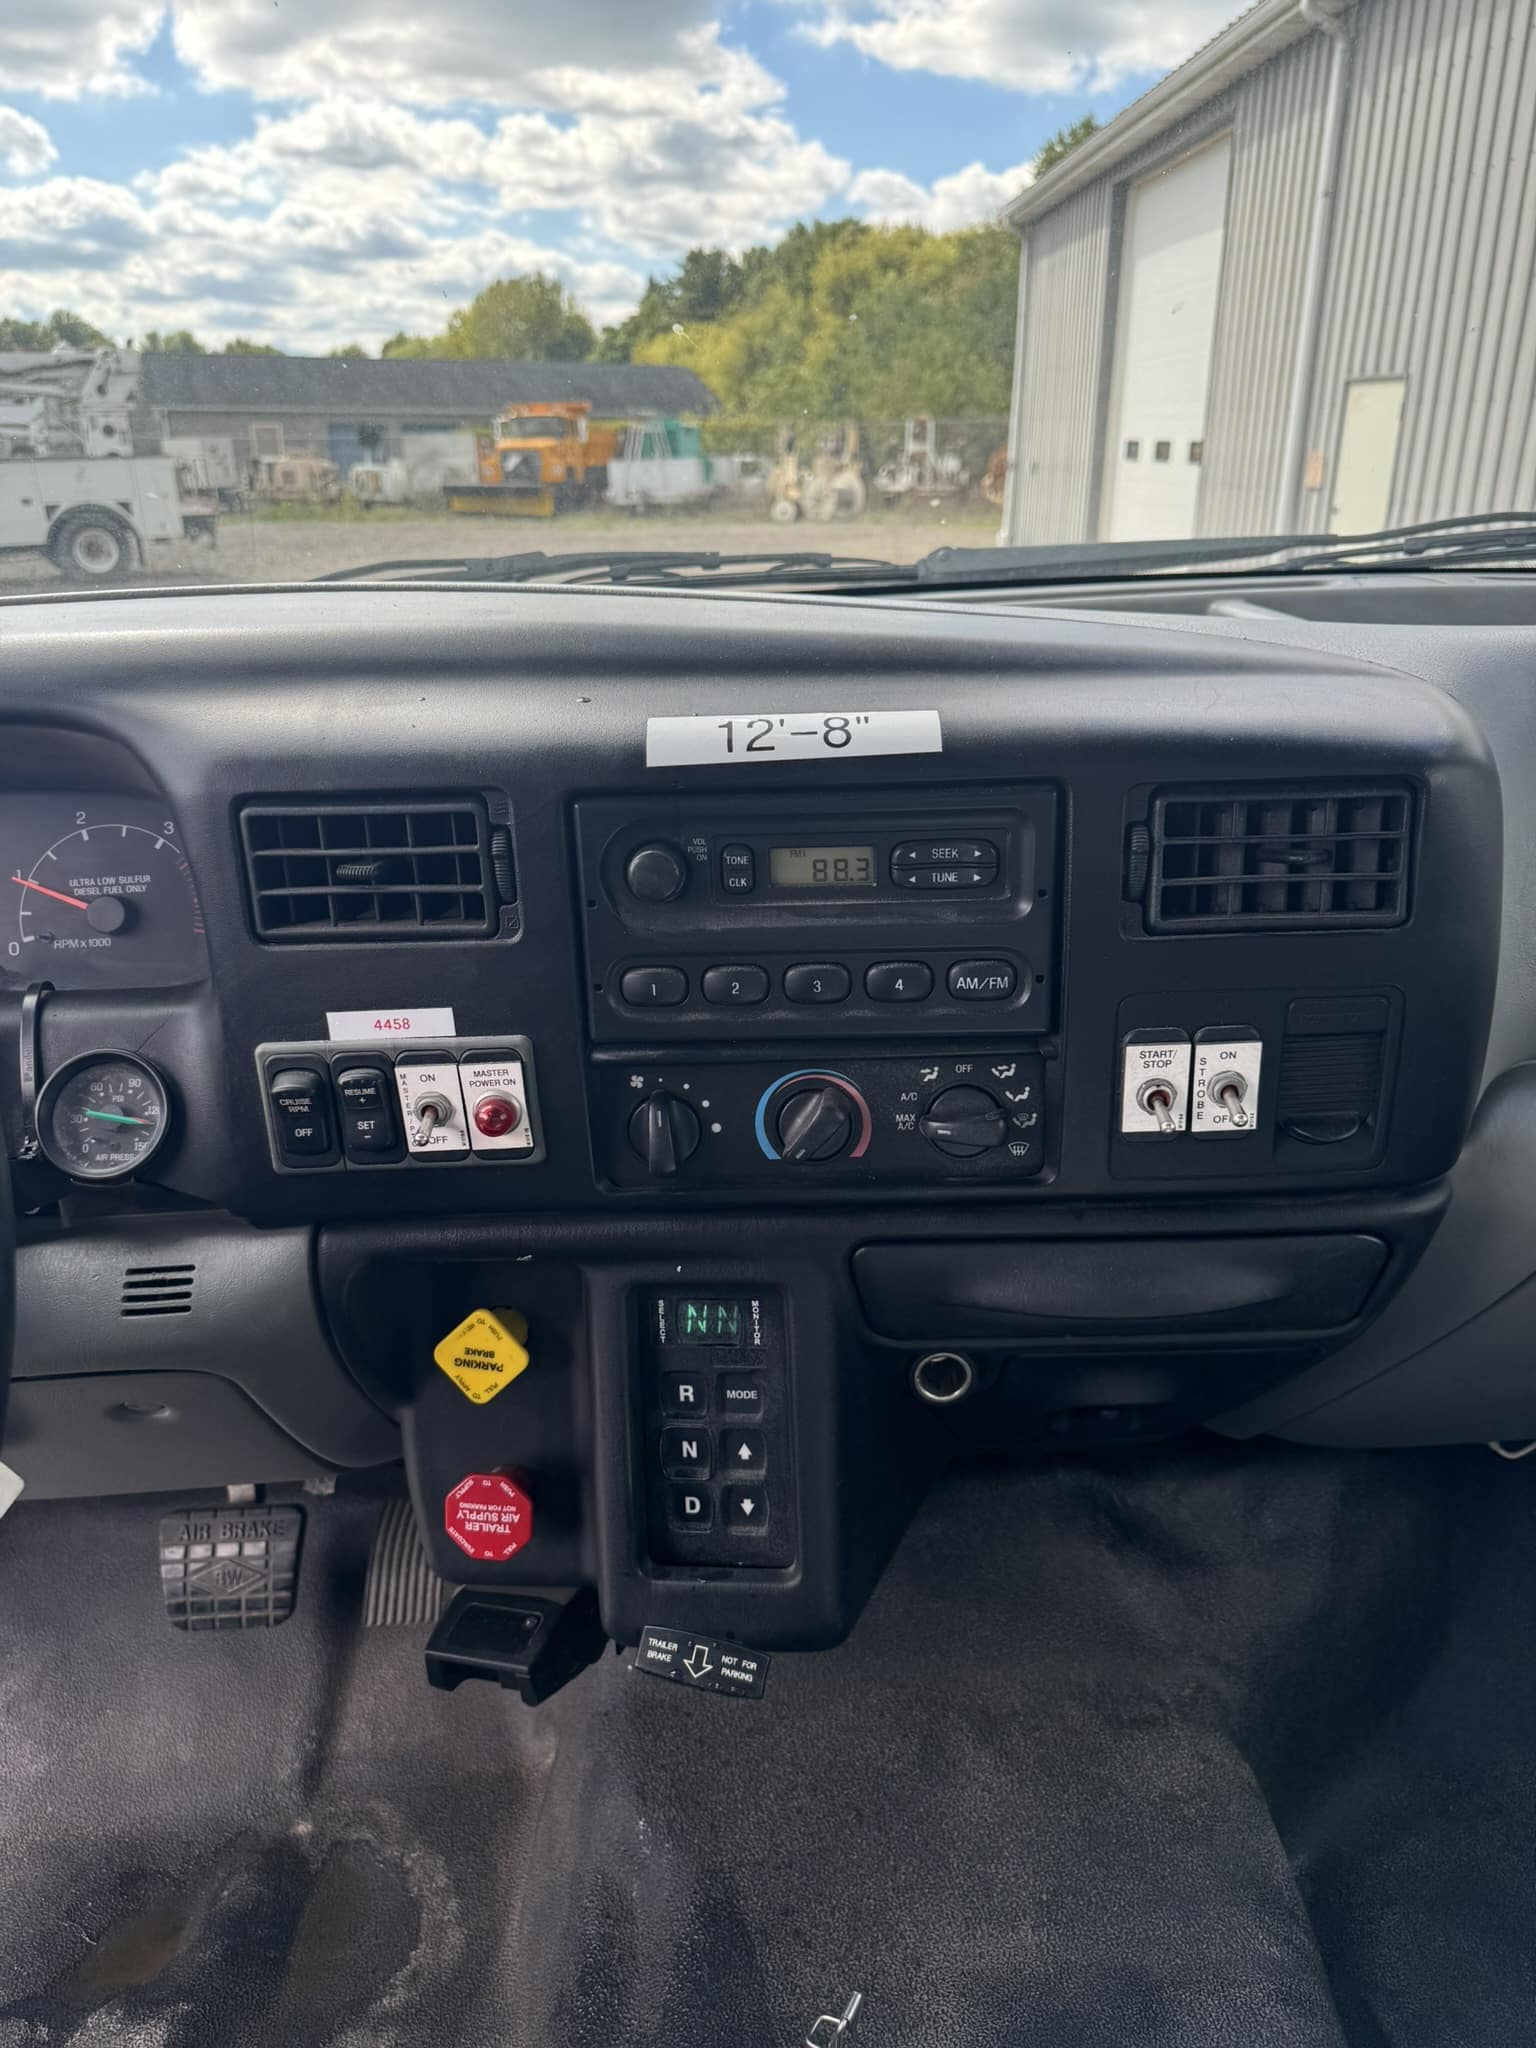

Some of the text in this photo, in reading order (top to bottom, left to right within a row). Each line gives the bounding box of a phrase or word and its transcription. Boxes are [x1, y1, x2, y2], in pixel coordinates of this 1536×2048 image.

[76, 811, 86, 825] 2
[163, 821, 174, 834] 3
[931, 847, 959, 860] SEEK
[726, 855, 749, 865] TONE
[813, 858, 870, 881] 88.3
[69, 875, 151, 887] ULTRA LOW SULFUR
[728, 877, 747, 887] CLK
[931, 871, 958, 884] TUNE
[74, 884, 148, 896] DIESEL FUEL ONLY
[8, 942, 20, 956] 0
[53, 939, 80, 949] RPM
[88, 937, 111, 948] 1000
[731, 981, 740, 994] 2
[813, 980, 821, 993] 3
[895, 978, 903, 991] 4
[956, 976, 1009, 990] AM/FM
[650, 983, 656, 996] 1
[374, 1018, 411, 1030] 4458
[1139, 1050, 1178, 1060] START/
[1219, 1051, 1237, 1060] ON
[955, 1064, 973, 1073] OFF
[1143, 1060, 1172, 1069] STOP
[419, 1073, 436, 1083] ON
[473, 1069, 509, 1077] MASTER
[90, 1082, 103, 1091] 60
[128, 1078, 141, 1088] 90
[503, 1078, 516, 1086] ON
[344, 1087, 376, 1096] RESUME
[1197, 1057, 1207, 1120] STROBE
[900, 1092, 918, 1101] A/C
[71, 1115, 83, 1124] 30
[896, 1114, 916, 1122] MAX
[357, 1121, 375, 1130] SET
[898, 1121, 914, 1130] A/C
[295, 1128, 313, 1137] OFF
[429, 1135, 448, 1145] OFF
[82, 1144, 89, 1153] 0
[658, 1299, 666, 1343] SELECT
[752, 1300, 761, 1345] MONITOR
[464, 1347, 495, 1359] BRAKE
[454, 1358, 504, 1373] PARKING
[472, 1392, 481, 1400] TO
[679, 1385, 694, 1402] R
[726, 1390, 758, 1400] MODE
[682, 1441, 698, 1458] N
[455, 1479, 474, 1499] SUPPLY
[500, 1481, 515, 1497] PUSH
[459, 1502, 487, 1510] PARKING
[685, 1496, 701, 1514] D
[456, 1509, 520, 1523] AIR SUPPLY
[179, 1520, 286, 1542] AIR BRAKE
[464, 1521, 511, 1533] TRAILER
[648, 1637, 678, 1652] TRAILER
[646, 1649, 672, 1663] BRAKE
[721, 1655, 757, 1671] NOT FOR
[720, 1667, 753, 1682] PARKING
